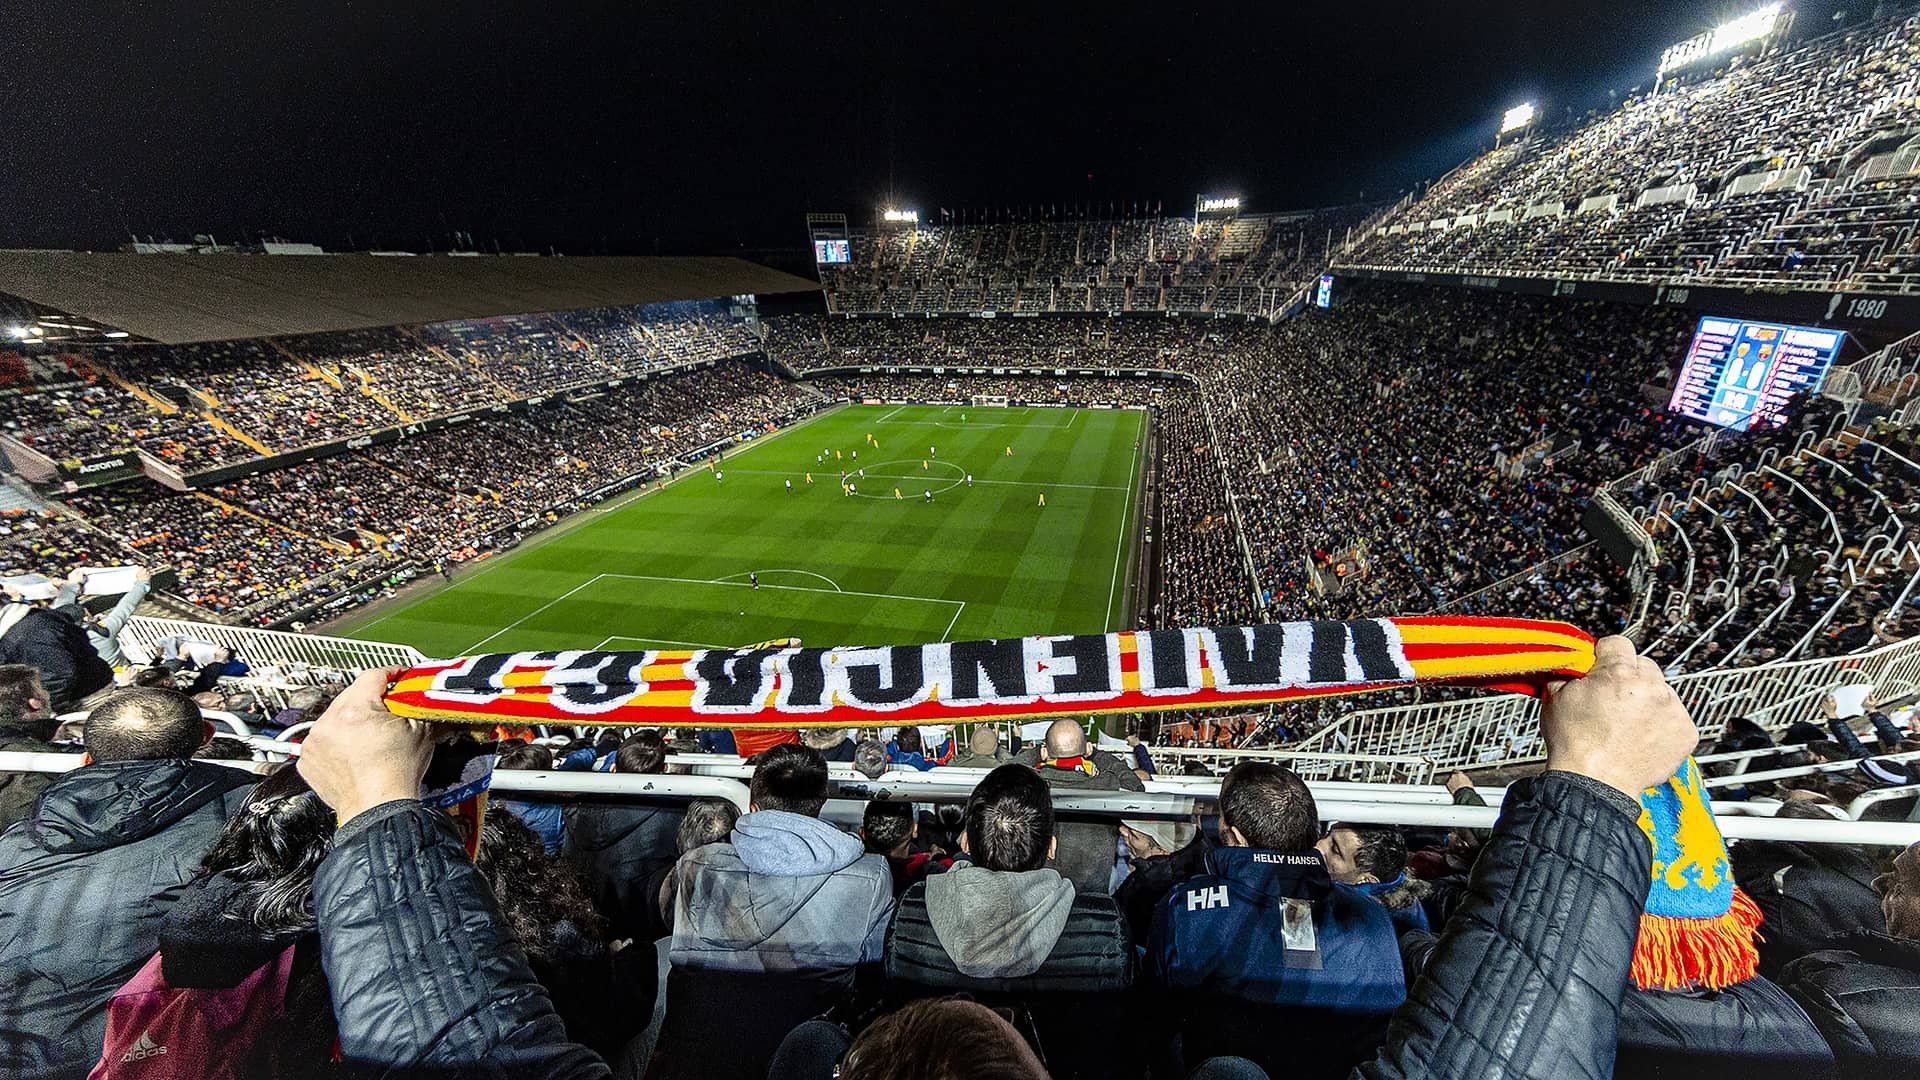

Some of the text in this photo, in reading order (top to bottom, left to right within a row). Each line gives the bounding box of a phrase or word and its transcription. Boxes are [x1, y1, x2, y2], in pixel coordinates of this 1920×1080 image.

[1846, 298, 1888, 319] 1980
[1253, 853, 1321, 865] HELLY HANSEN
[1187, 885, 1229, 911] HH
